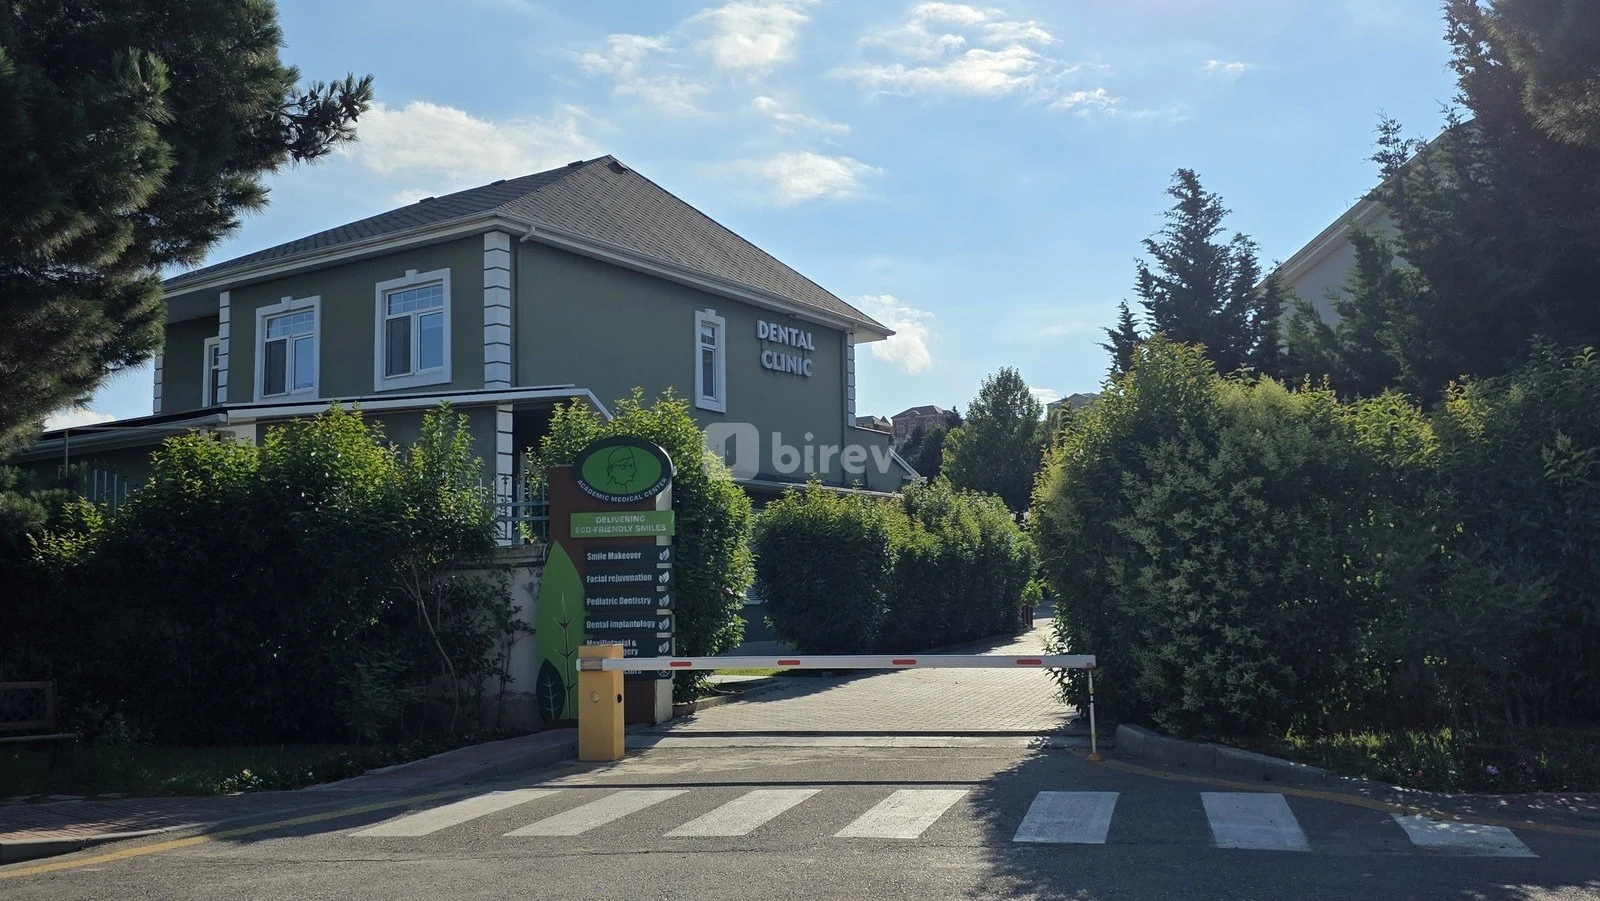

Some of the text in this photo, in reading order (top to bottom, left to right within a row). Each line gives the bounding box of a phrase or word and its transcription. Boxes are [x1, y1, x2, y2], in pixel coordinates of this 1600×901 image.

[756, 319, 815, 351] DENTAL
[760, 349, 813, 377] CLINIC
[576, 477, 668, 503] ACADEMIC MEDICAL CENTER
[595, 515, 646, 524] DELIVERING
[575, 524, 667, 534] ECO-FRIENDLY SMILES
[586, 551, 642, 561] Smile Makeover
[586, 573, 653, 583] Facial rejuvenation
[586, 596, 652, 606] Pediatric Dentistry
[586, 620, 609, 629] Dental
[631, 639, 637, 647] &
